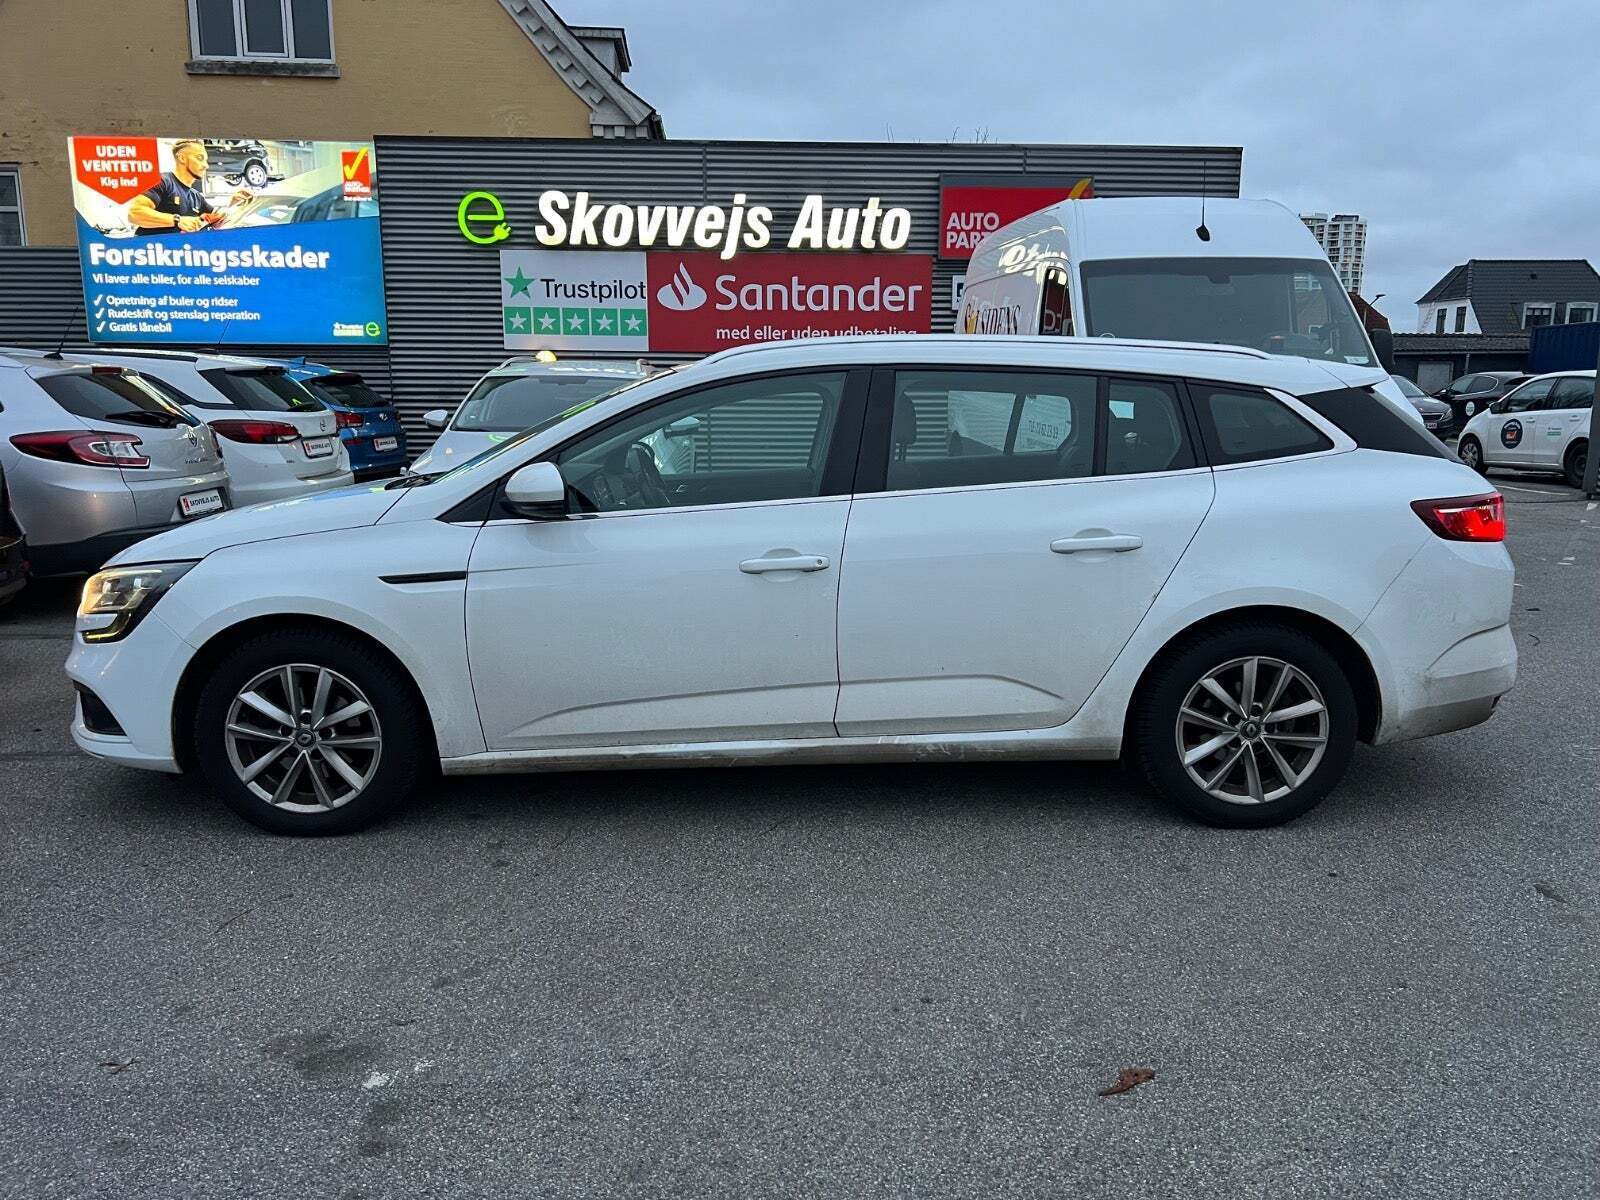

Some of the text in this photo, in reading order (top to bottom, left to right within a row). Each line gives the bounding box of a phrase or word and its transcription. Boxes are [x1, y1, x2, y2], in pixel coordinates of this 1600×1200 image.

[96, 145, 137, 157] UDEN
[82, 159, 153, 172] VENTETID
[100, 176, 138, 188] Kig ind
[534, 190, 912, 260] Skovvejs Auto
[946, 212, 1000, 230] AUTO
[89, 243, 330, 273] Forsikringsskader
[93, 273, 260, 286] Vi laver alle biler, for alle selskaber
[540, 278, 647, 303] Trustpilot
[715, 274, 922, 312] Santander
[106, 295, 238, 309] Opretning af buler og ridser
[107, 309, 260, 322] Rudeskift og stenslag reparation
[109, 322, 172, 333] Gratis lånebil
[716, 326, 917, 340] med eller uden udbtli
